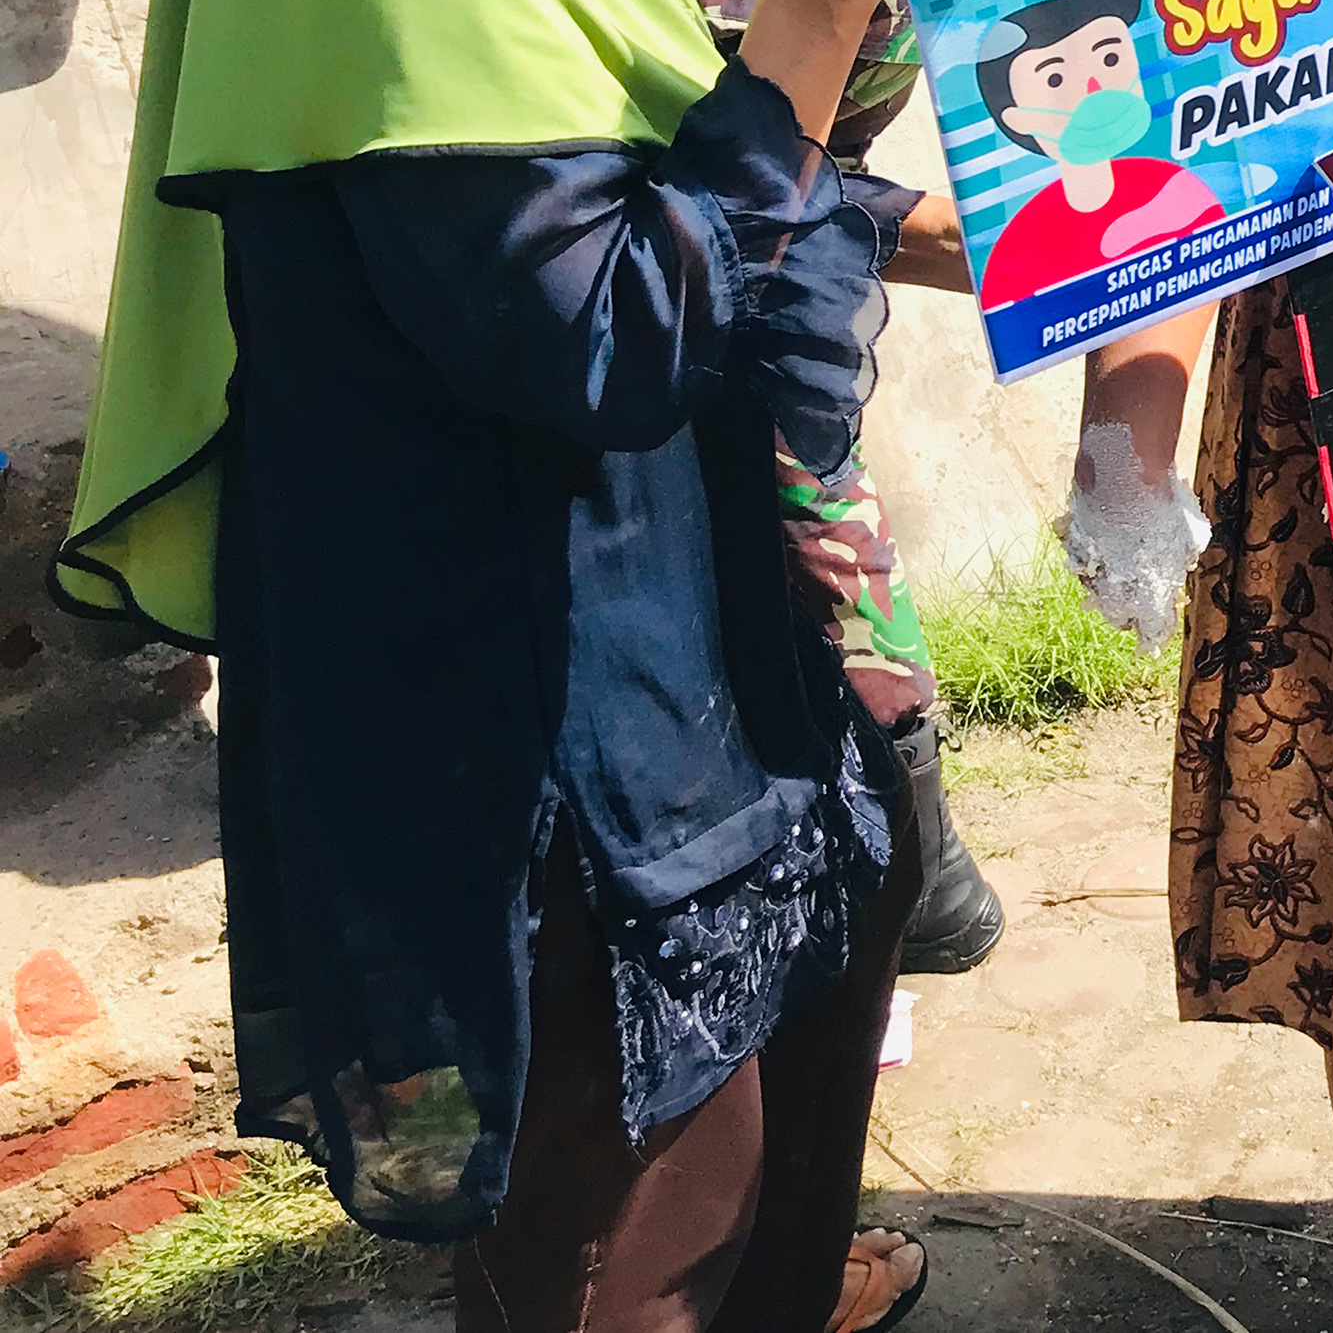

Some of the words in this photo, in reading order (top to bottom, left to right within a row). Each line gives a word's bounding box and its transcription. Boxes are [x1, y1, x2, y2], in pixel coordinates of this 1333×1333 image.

[1107, 254, 1173, 294] SATGAS
[1179, 206, 1294, 264] PENGAMANAN
[1297, 187, 1332, 218] DAN
[1042, 286, 1152, 348] PERCEPATAN
[1155, 243, 1267, 301] PENANGANAN
